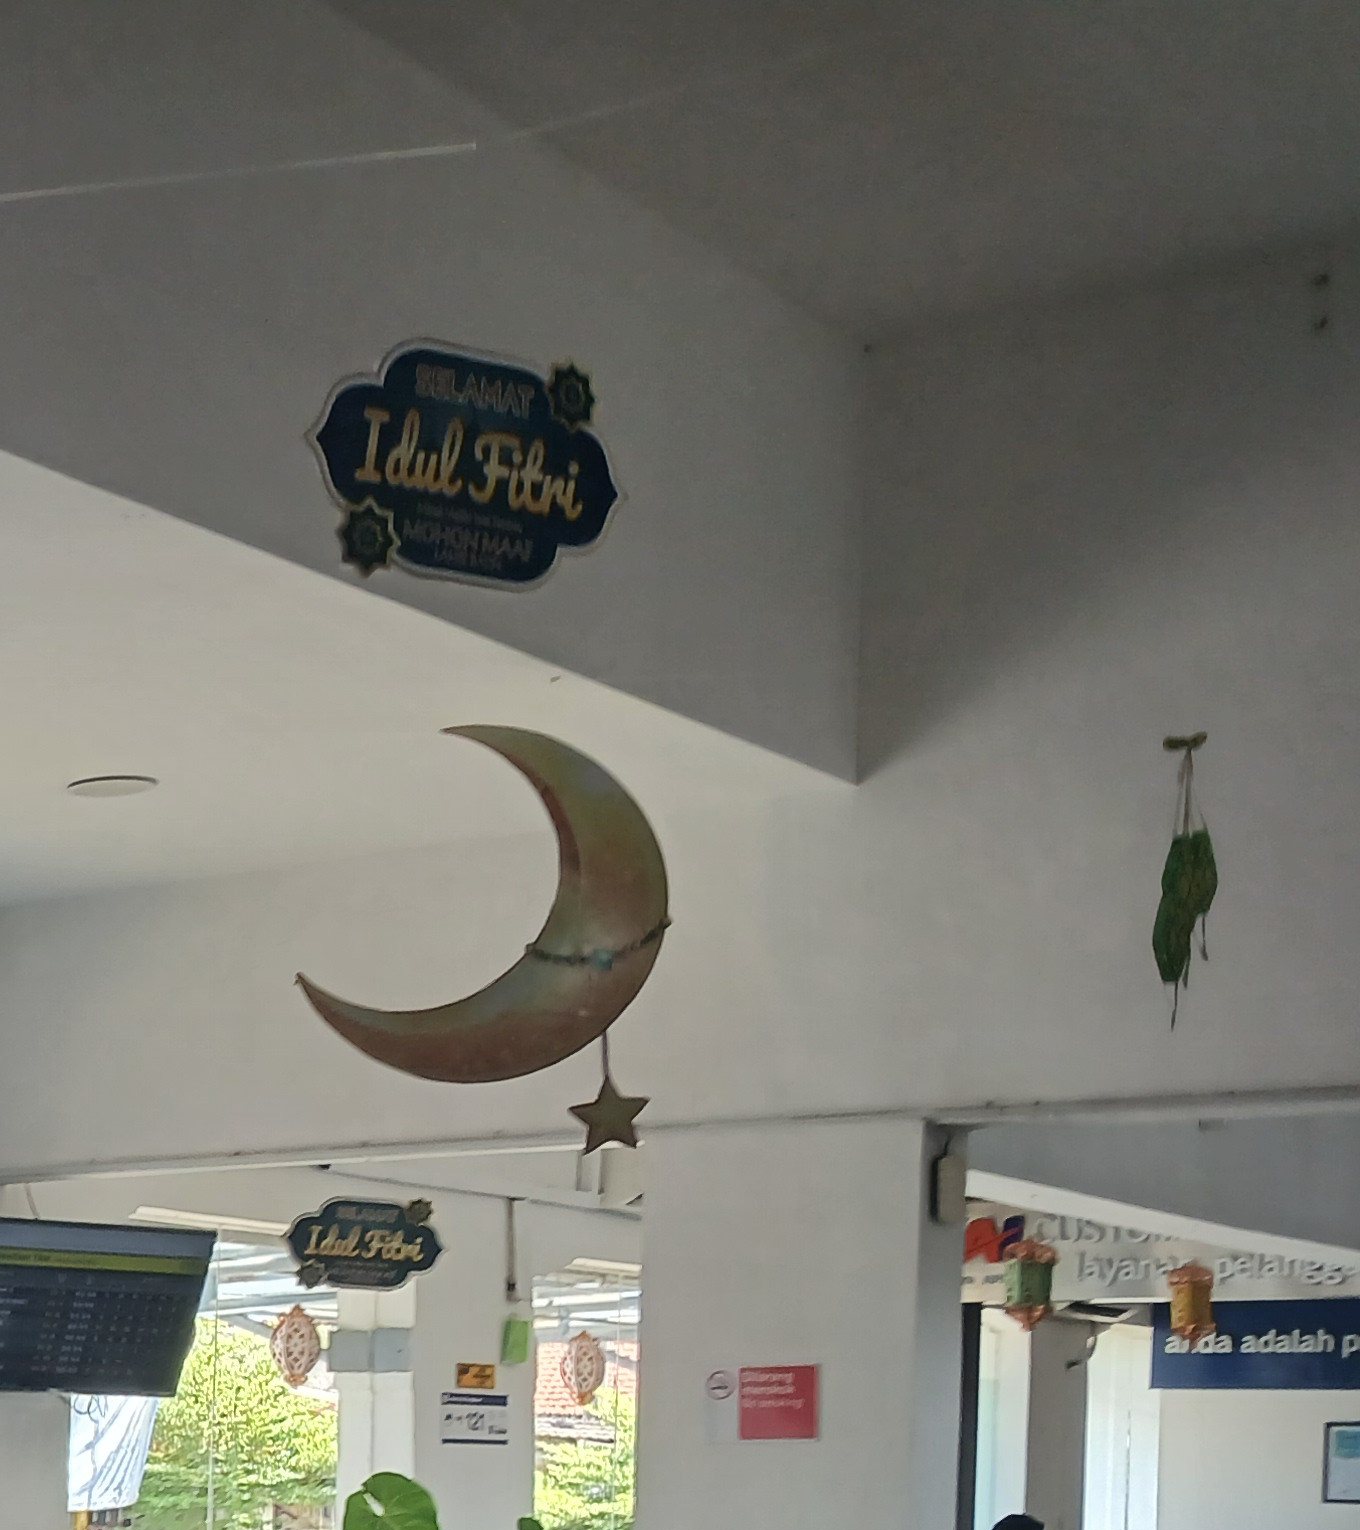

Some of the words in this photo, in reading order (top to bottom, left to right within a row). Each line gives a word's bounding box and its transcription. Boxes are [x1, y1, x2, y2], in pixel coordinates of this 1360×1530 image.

[355, 406, 464, 495] Idul
[468, 430, 583, 521] Fitri
[1239, 1328, 1336, 1354] adalah
